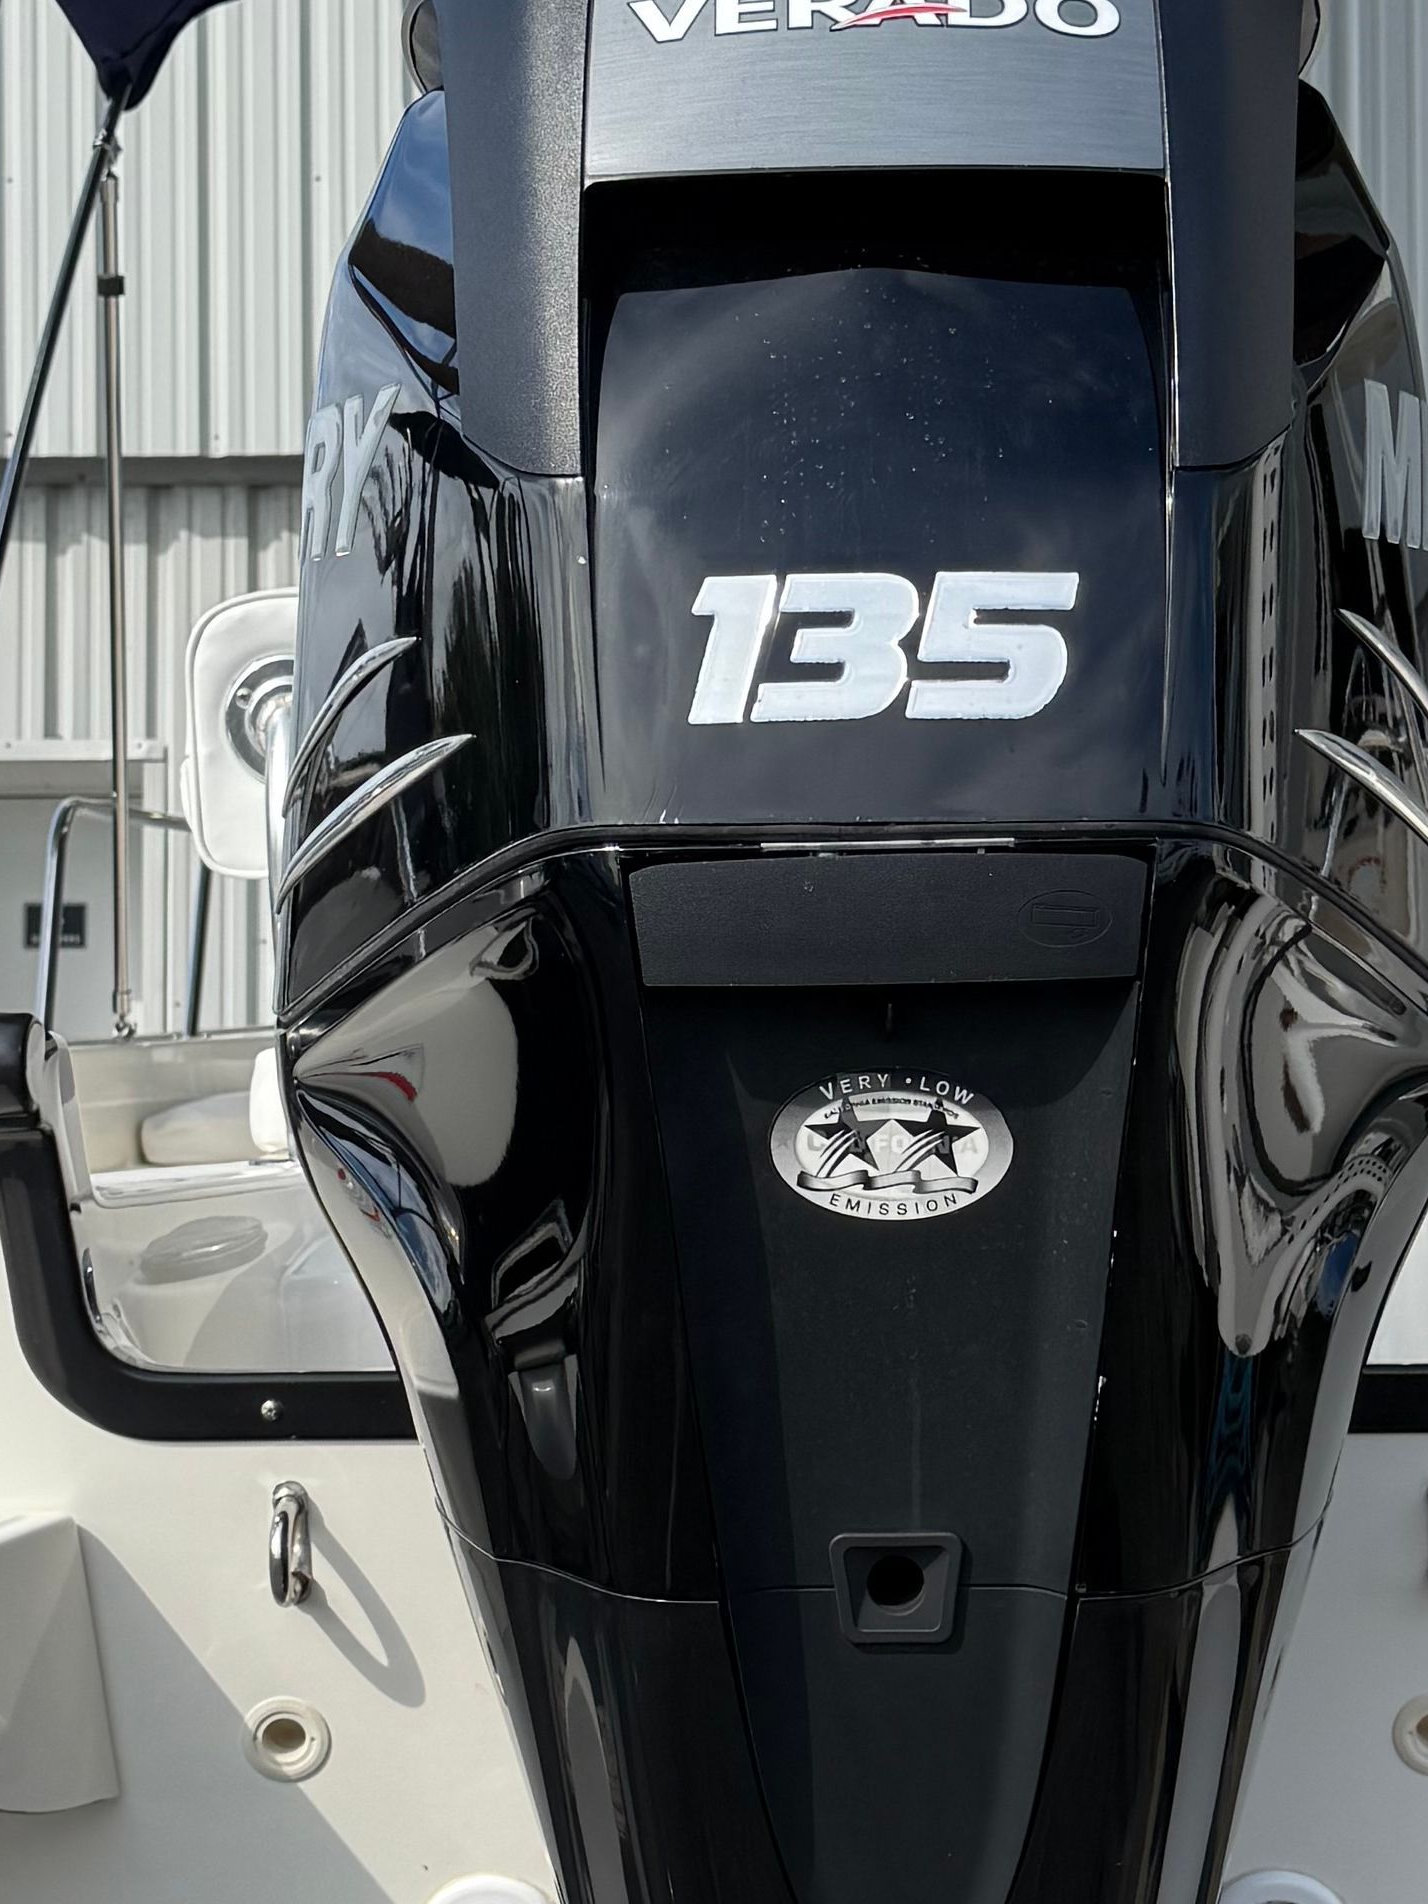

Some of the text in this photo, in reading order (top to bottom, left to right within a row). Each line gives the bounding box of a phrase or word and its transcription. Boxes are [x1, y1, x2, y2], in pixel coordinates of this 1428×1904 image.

[687, 571, 1080, 726] 135
[819, 1073, 975, 1105] VERY LOW
[829, 1193, 958, 1216] EMISSION
